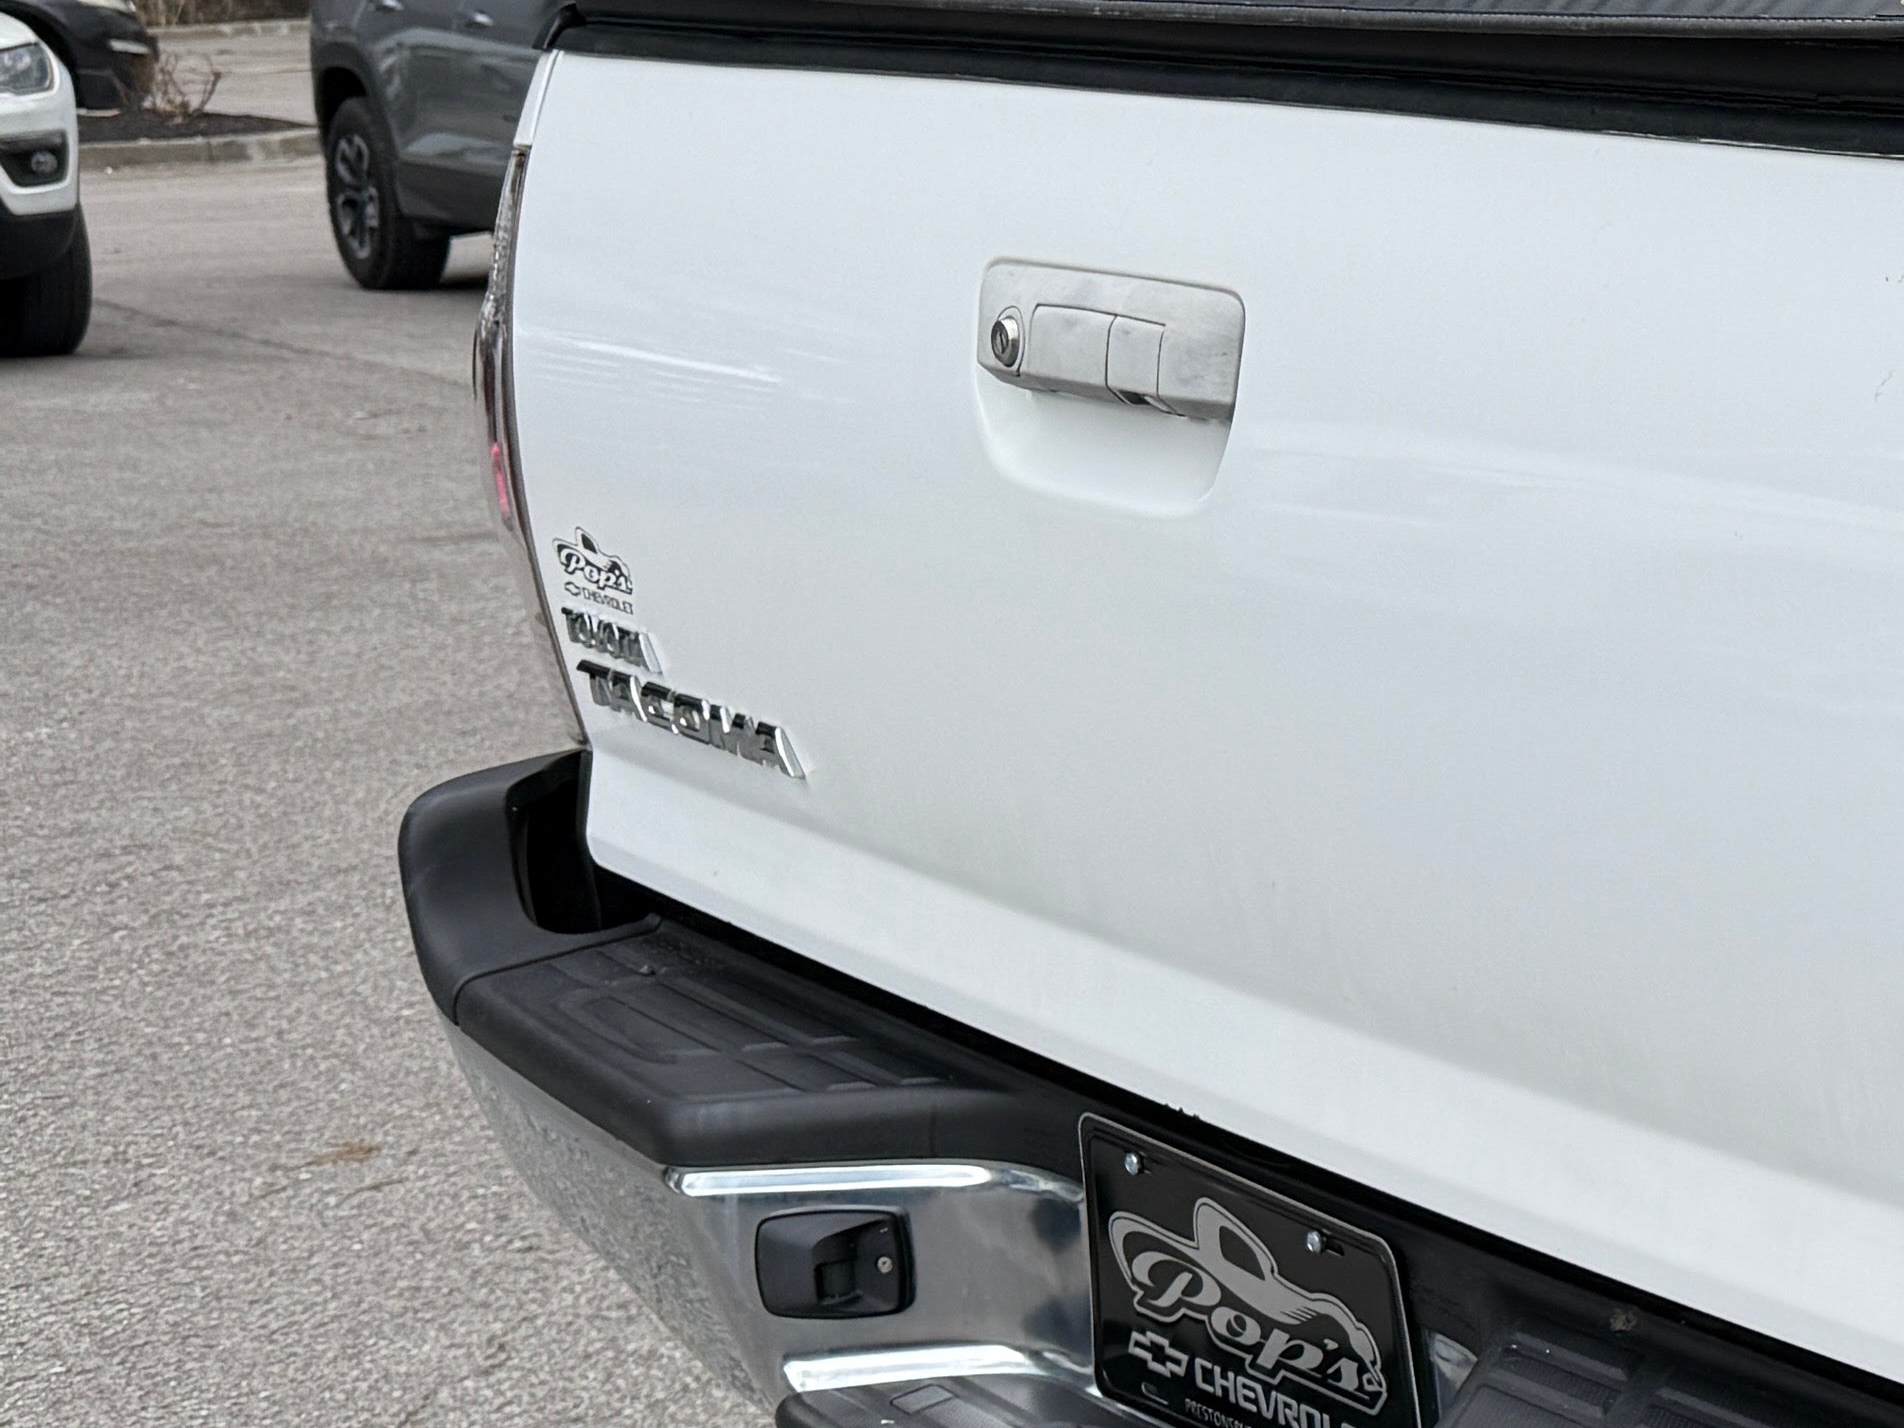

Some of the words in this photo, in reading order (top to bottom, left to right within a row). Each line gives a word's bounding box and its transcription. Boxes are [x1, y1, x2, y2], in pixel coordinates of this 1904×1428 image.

[582, 586, 634, 615] CHEVROLET
[576, 659, 806, 779] TACOMA
[1130, 1249, 1361, 1392] Pop's
